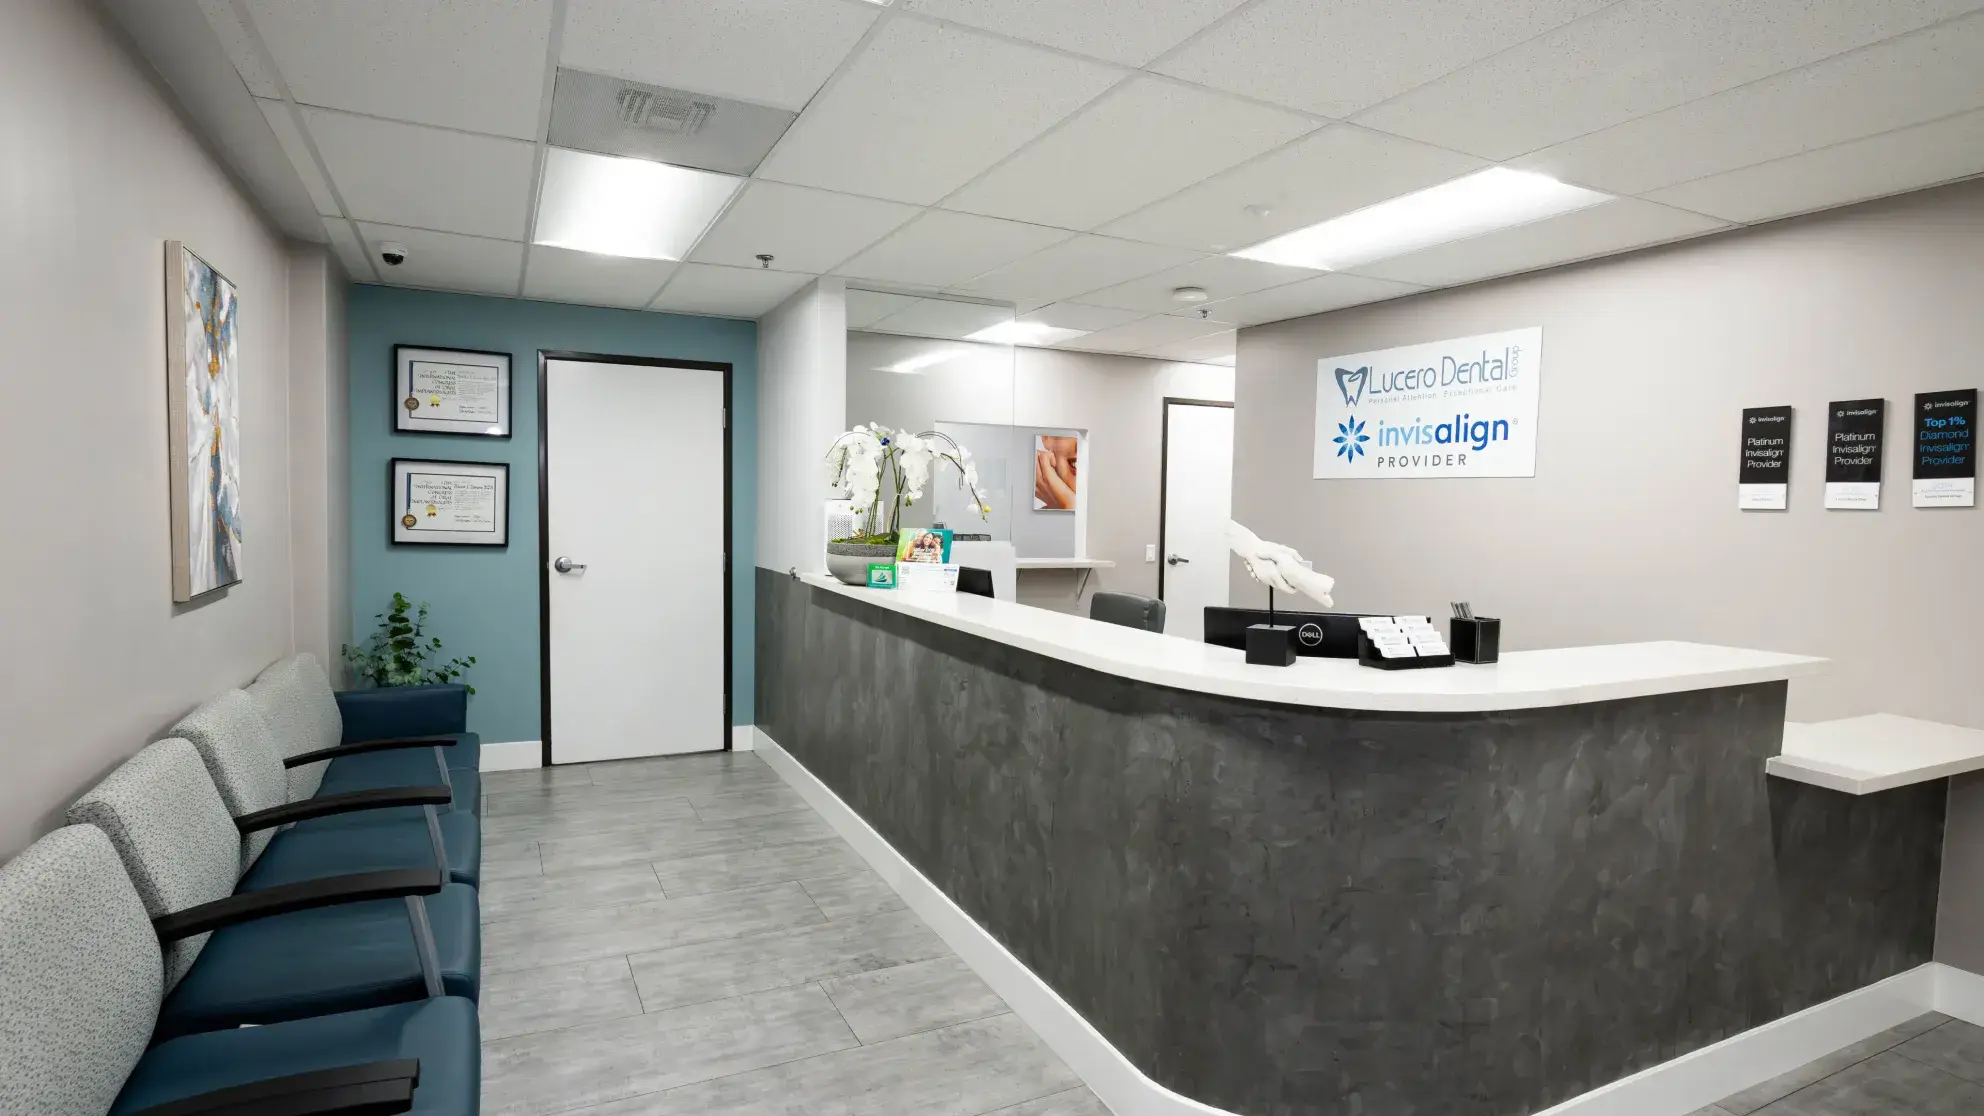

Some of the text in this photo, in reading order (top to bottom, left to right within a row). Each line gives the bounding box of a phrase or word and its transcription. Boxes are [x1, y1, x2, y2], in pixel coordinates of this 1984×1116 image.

[1509, 345, 1523, 378] Group
[1369, 347, 1509, 394] Lucero Dental
[1401, 391, 1437, 402] Attention
[1934, 400, 1969, 408] invisalign
[1846, 408, 1878, 417] invisalign
[1758, 415, 1784, 424] invisalign
[1924, 416, 1966, 428] Top 1%
[1835, 432, 1875, 442] Platinum
[1920, 429, 1969, 440] Diamond
[1747, 437, 1784, 447] Platinum
[1919, 442, 1970, 453] Invisalign
[1745, 448, 1784, 459] Invisalign
[1832, 443, 1876, 455] Invisalign
[1378, 453, 1468, 468] PROVIDER
[1747, 459, 1782, 469] Provider
[1834, 455, 1873, 466] Provider
[1921, 455, 1966, 466] Provider
[1301, 631, 1320, 639] DELL
